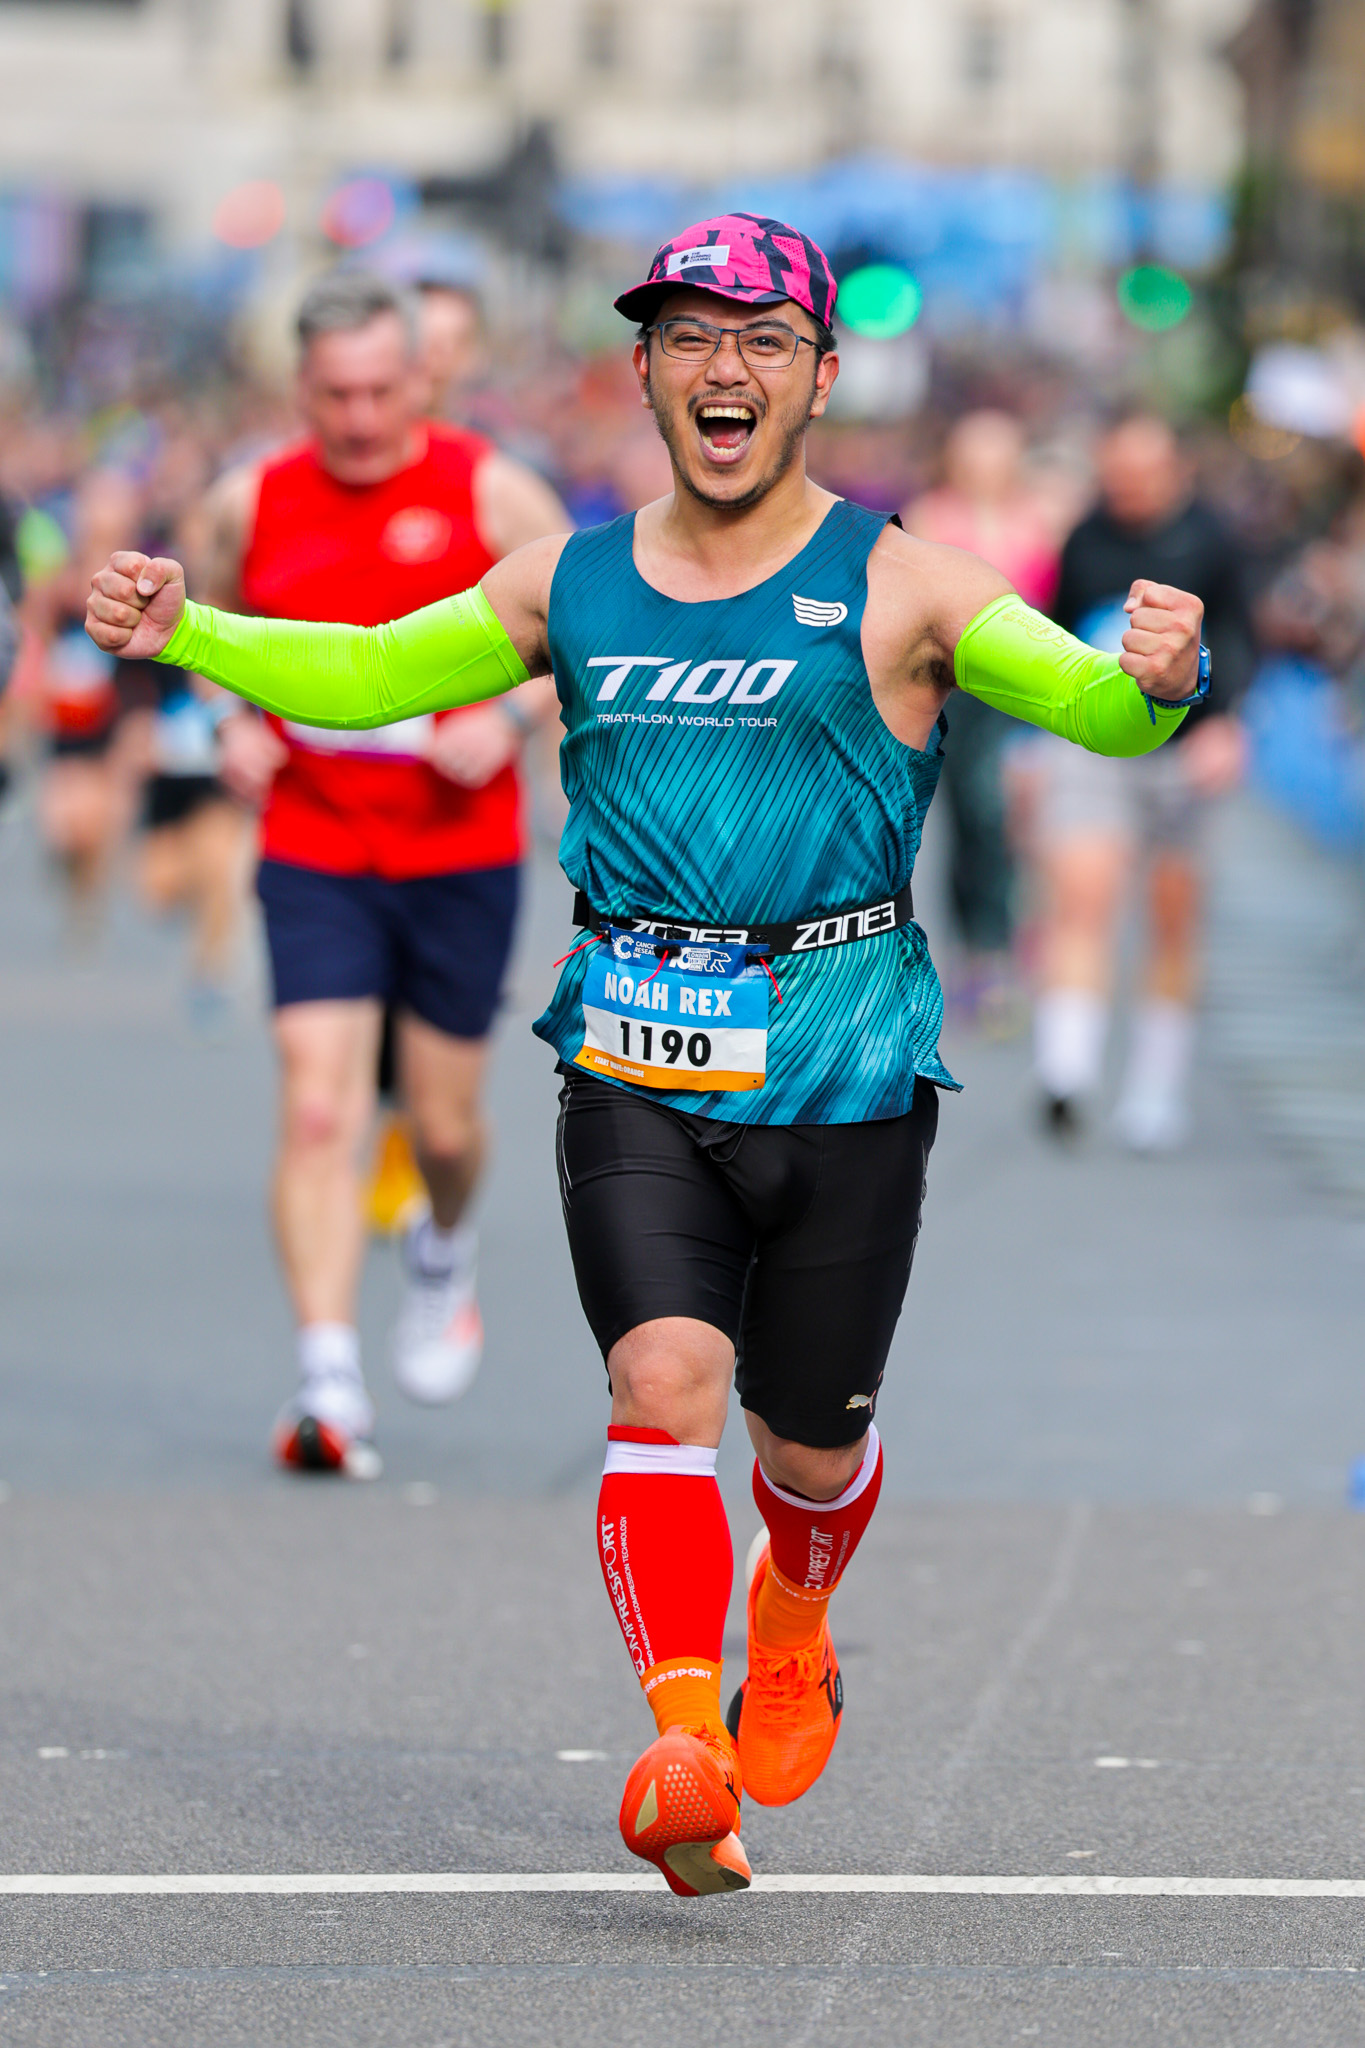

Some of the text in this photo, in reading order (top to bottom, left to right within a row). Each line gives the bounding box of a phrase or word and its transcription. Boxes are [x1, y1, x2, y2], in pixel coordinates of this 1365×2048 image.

[586, 656, 799, 704] T100
[597, 713, 778, 728] TRIATHLON WORLD TOUR
[636, 941, 657, 950] CANCE
[791, 901, 896, 951] ZONE3
[605, 971, 733, 1017] NOAH REX
[593, 1056, 610, 1067] START
[620, 1020, 712, 1067] 1190
[620, 1516, 629, 1563] TECHNOLOGY
[624, 1563, 641, 1613] COMPRESSION
